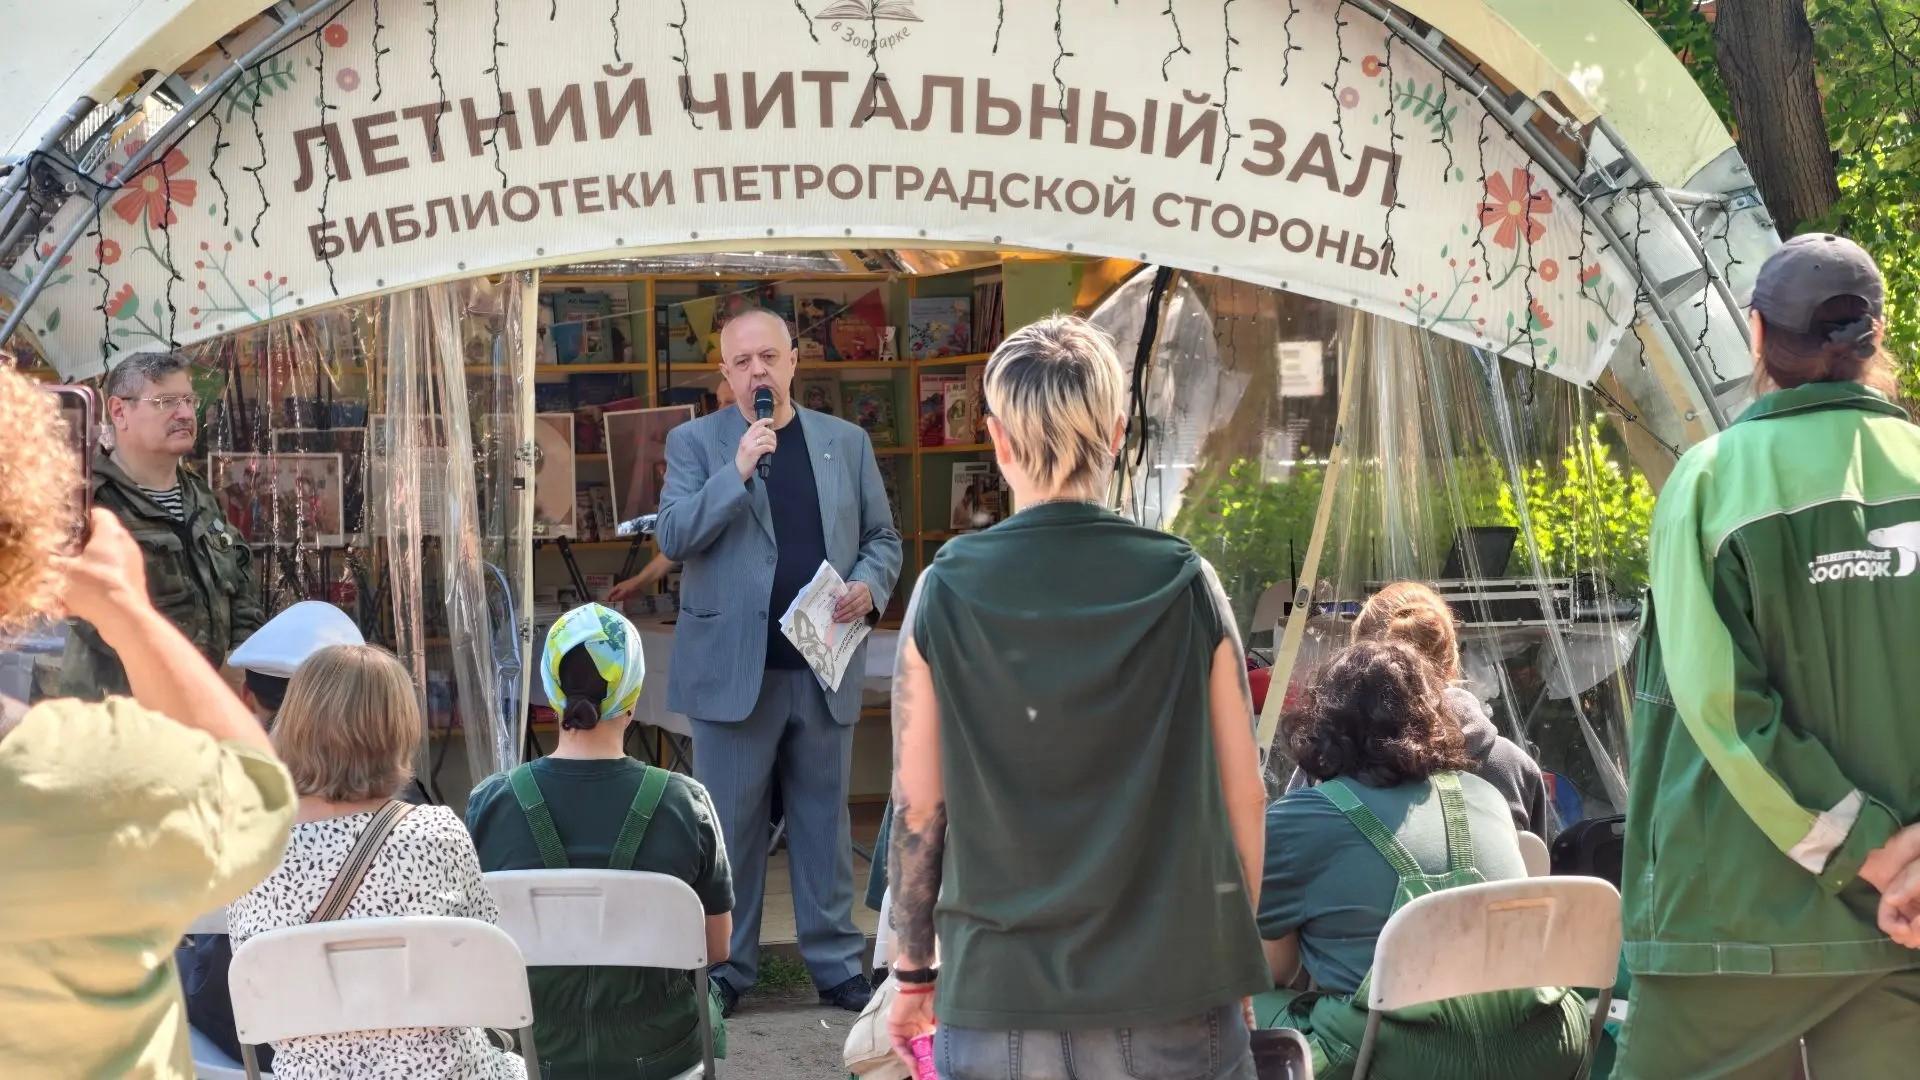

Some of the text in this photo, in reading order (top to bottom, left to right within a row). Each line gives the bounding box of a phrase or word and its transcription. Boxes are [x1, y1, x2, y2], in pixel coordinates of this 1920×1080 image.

[291, 62, 1403, 205] ЛЕТНИЙ ЧИТАЛЬНЫЙ ЗАЛ
[307, 162, 1392, 275] БИБЛИОТЕКИ ПЕТРОГРАДСКОЙ СТОРОНЫ
